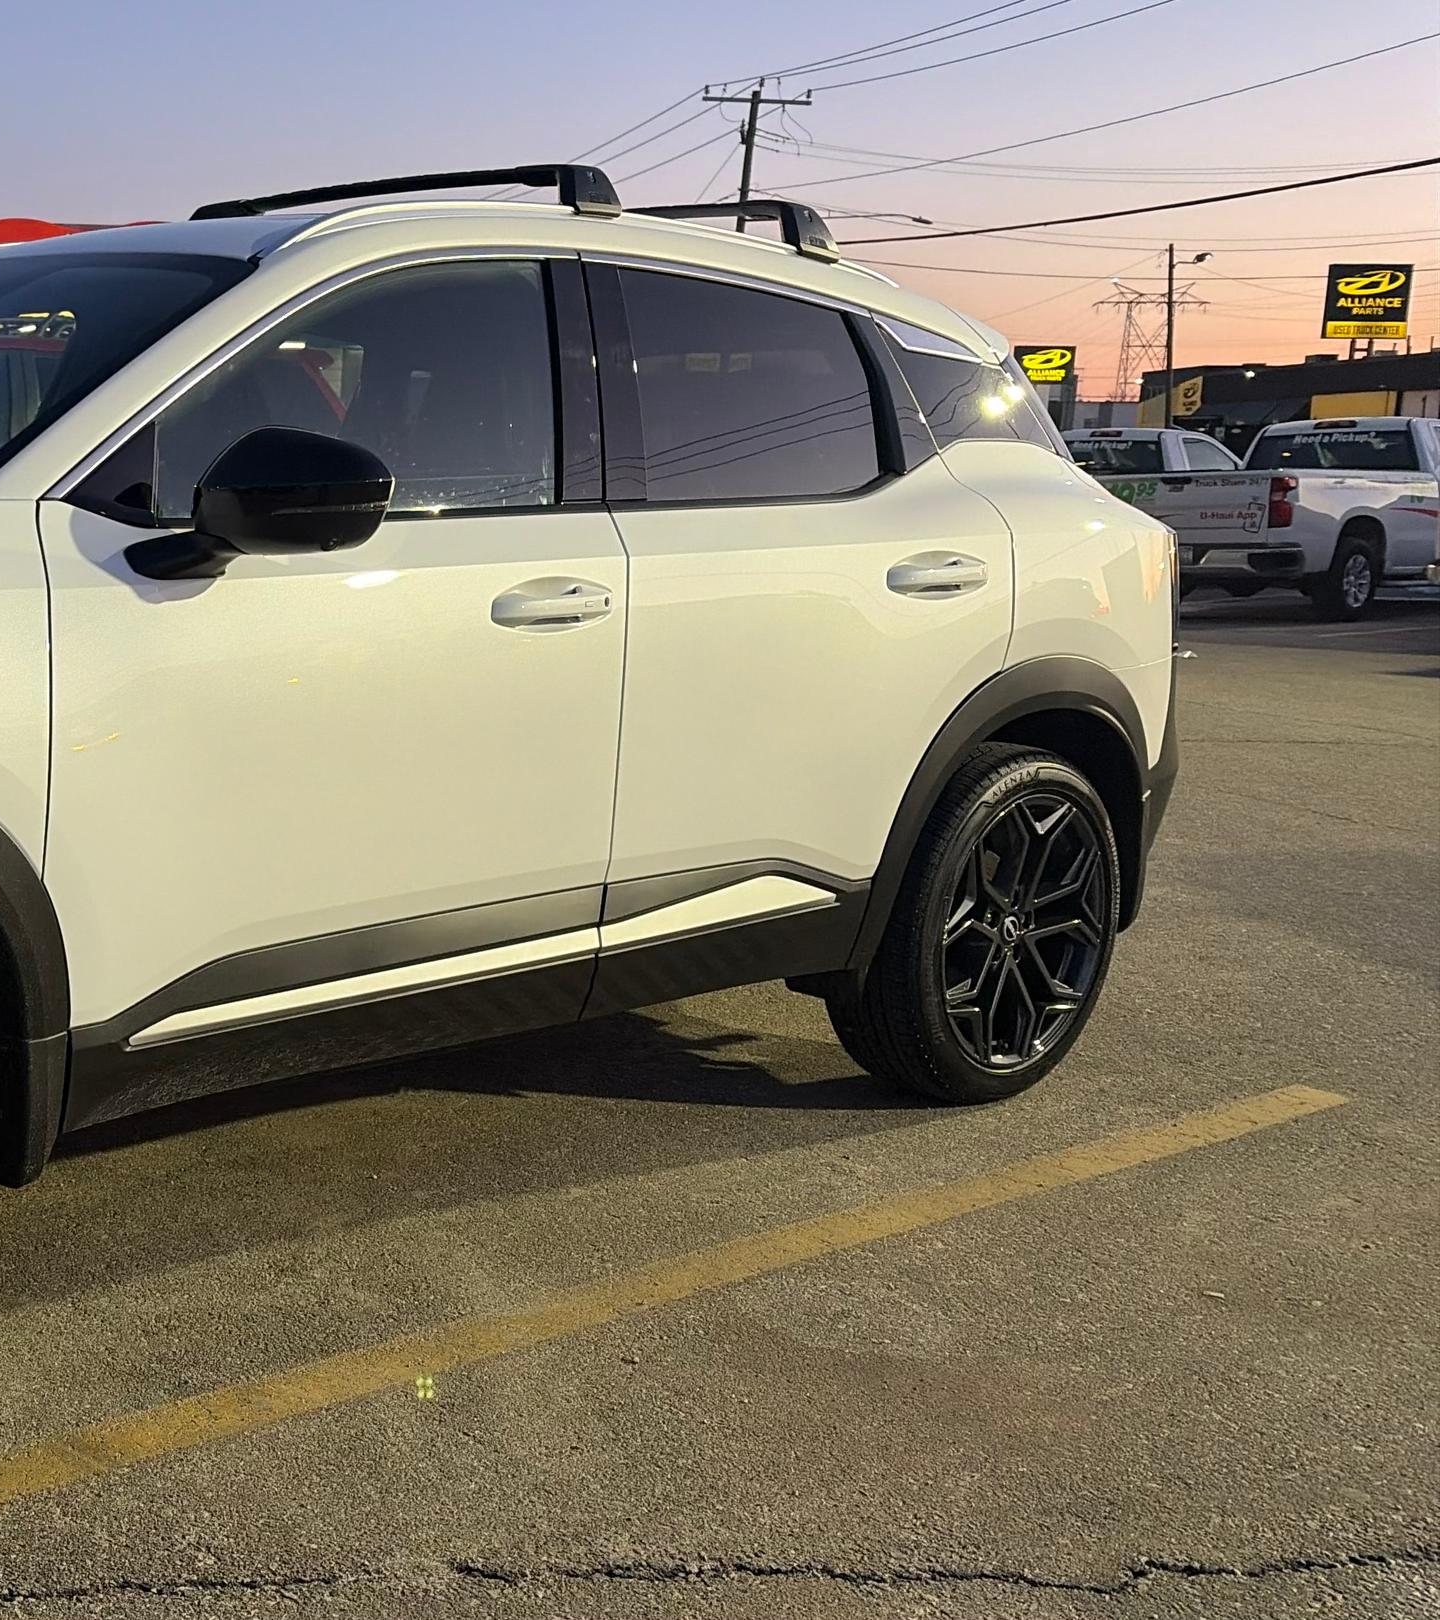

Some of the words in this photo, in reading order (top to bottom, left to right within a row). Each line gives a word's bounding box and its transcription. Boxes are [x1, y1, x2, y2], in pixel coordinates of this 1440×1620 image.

[1336, 298, 1402, 307] ALLIANCE
[1293, 434, 1322, 444] Need
[1331, 432, 1376, 443] Pickup?
[1195, 480, 1218, 488] Truck
[1200, 511, 1234, 520] U-Haul
[1236, 511, 1258, 521] App
